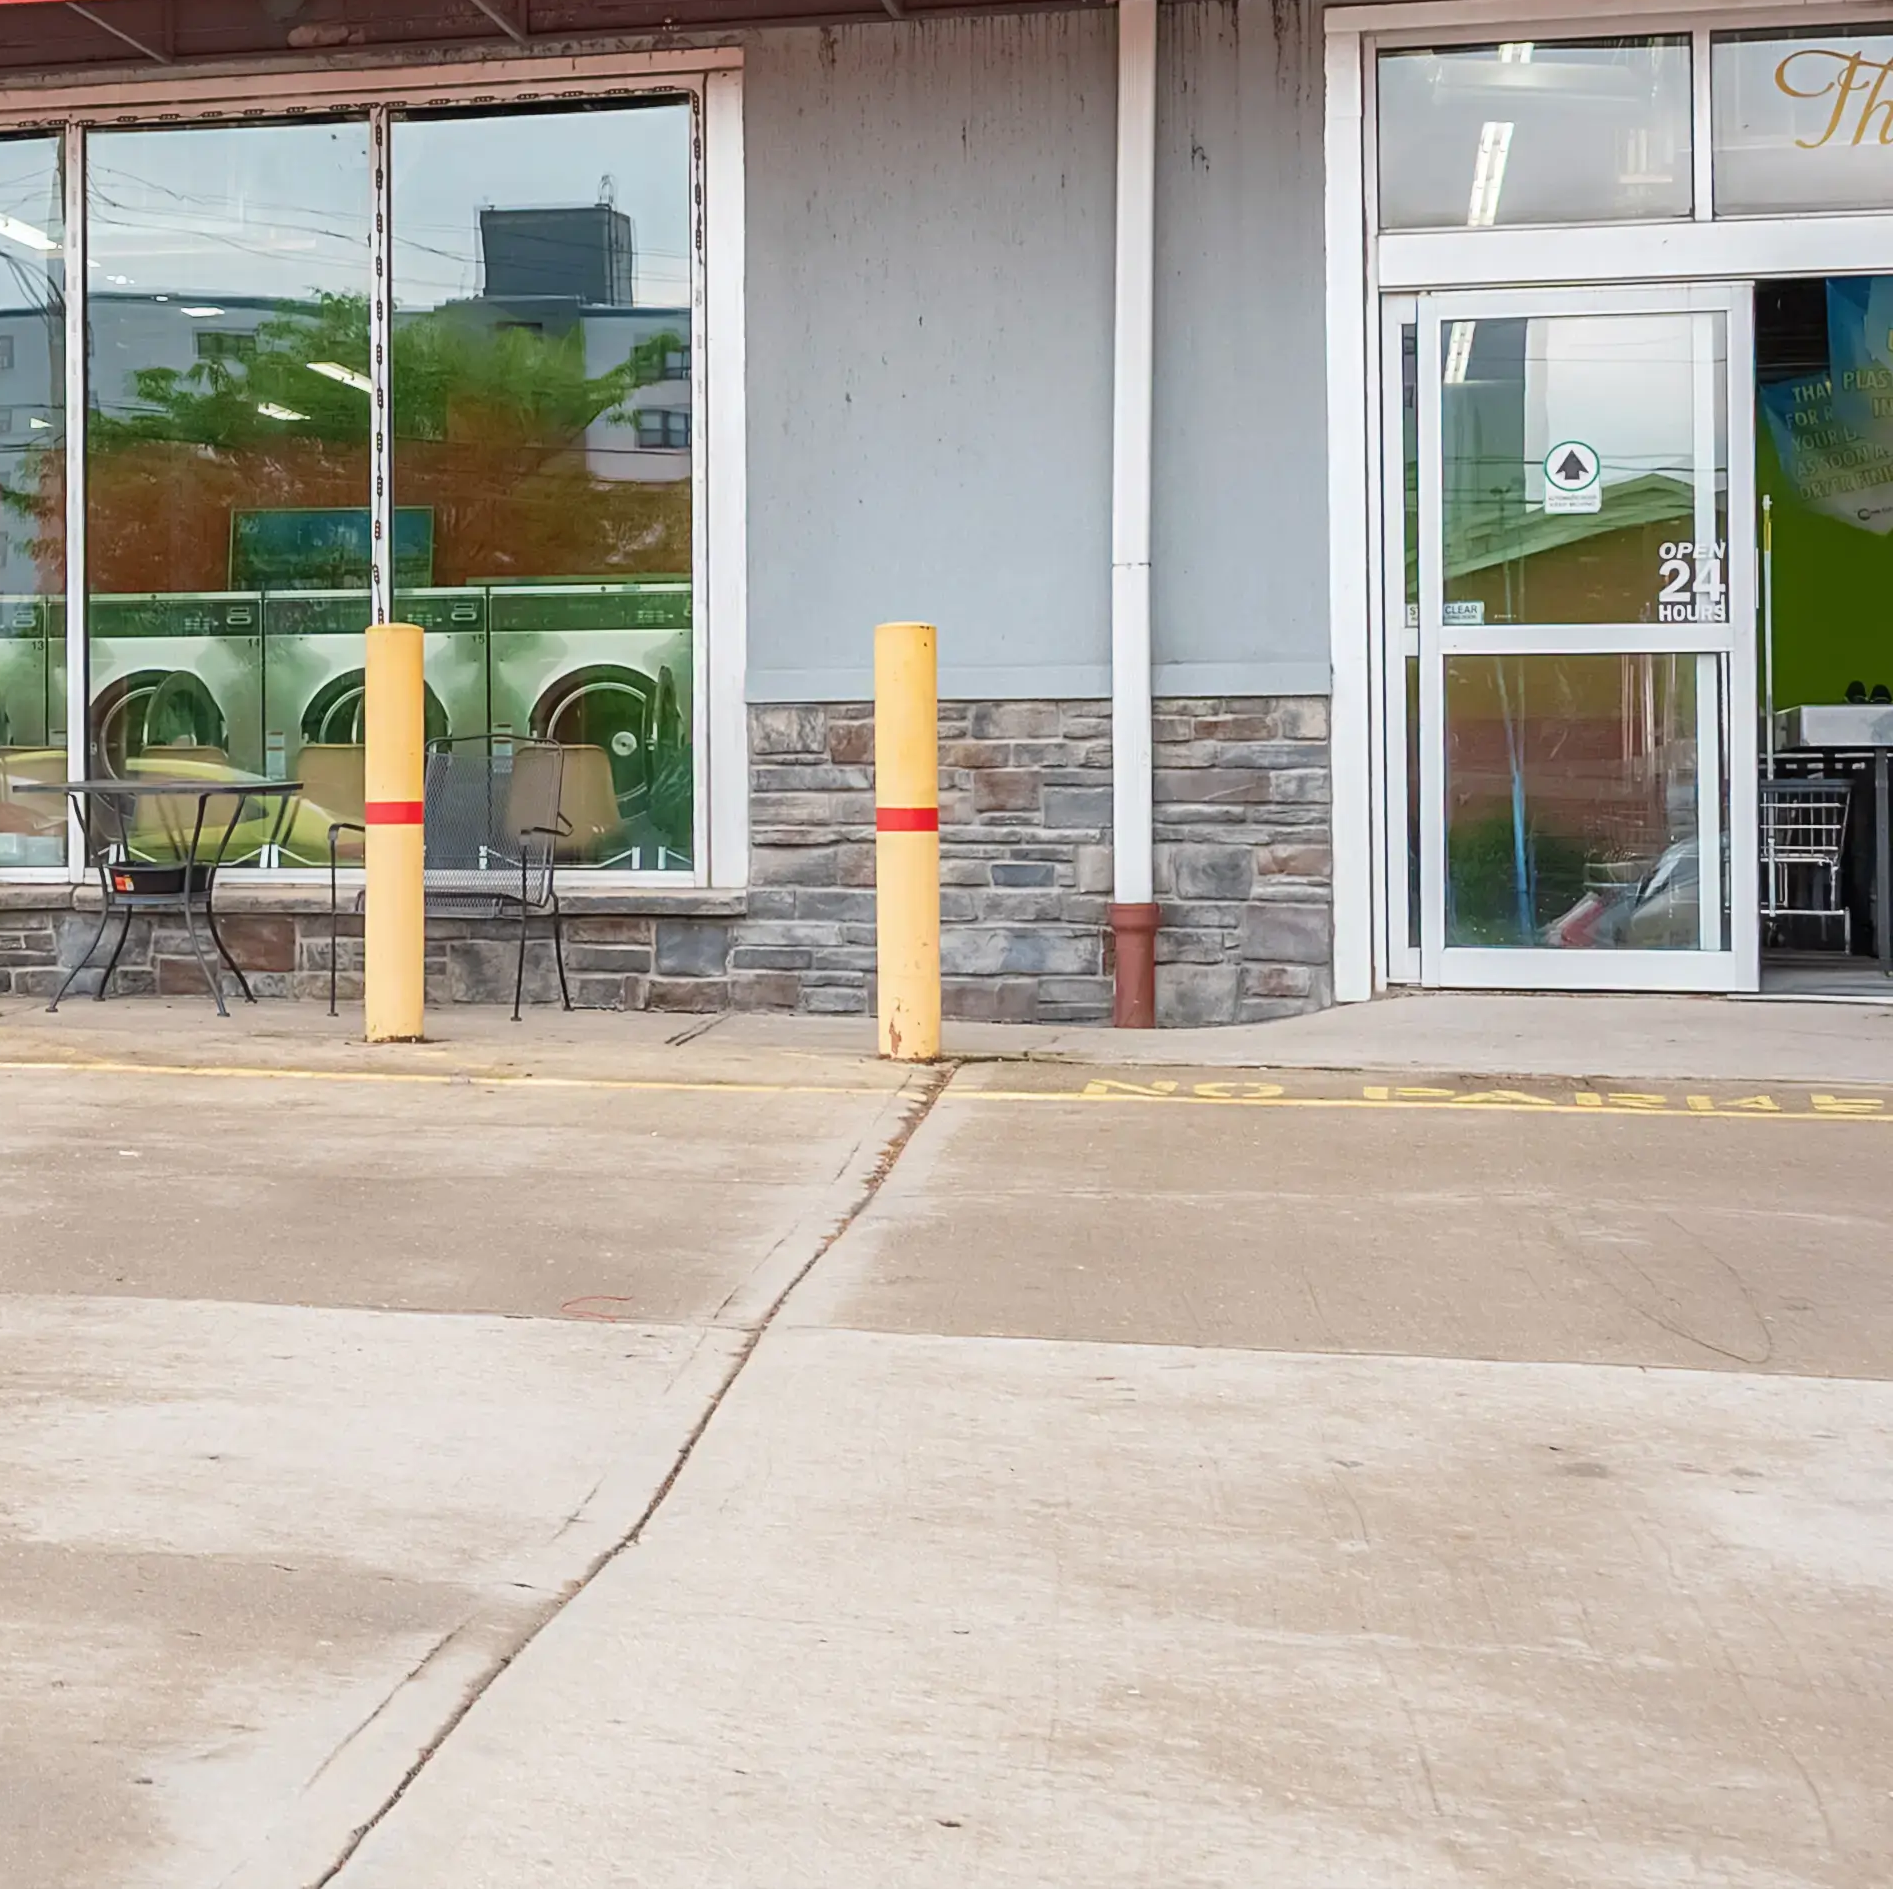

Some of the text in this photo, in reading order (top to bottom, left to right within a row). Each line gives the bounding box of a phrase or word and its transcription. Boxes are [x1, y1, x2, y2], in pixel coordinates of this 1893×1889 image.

[1785, 411, 1819, 430] FOR
[1792, 429, 1838, 453] YOUR
[1658, 541, 1726, 559] OPEN
[1658, 559, 1726, 602] 24
[1444, 604, 1478, 614] CLEAR
[1658, 604, 1726, 622] HOURS
[1083, 1078, 1285, 1098] NO
